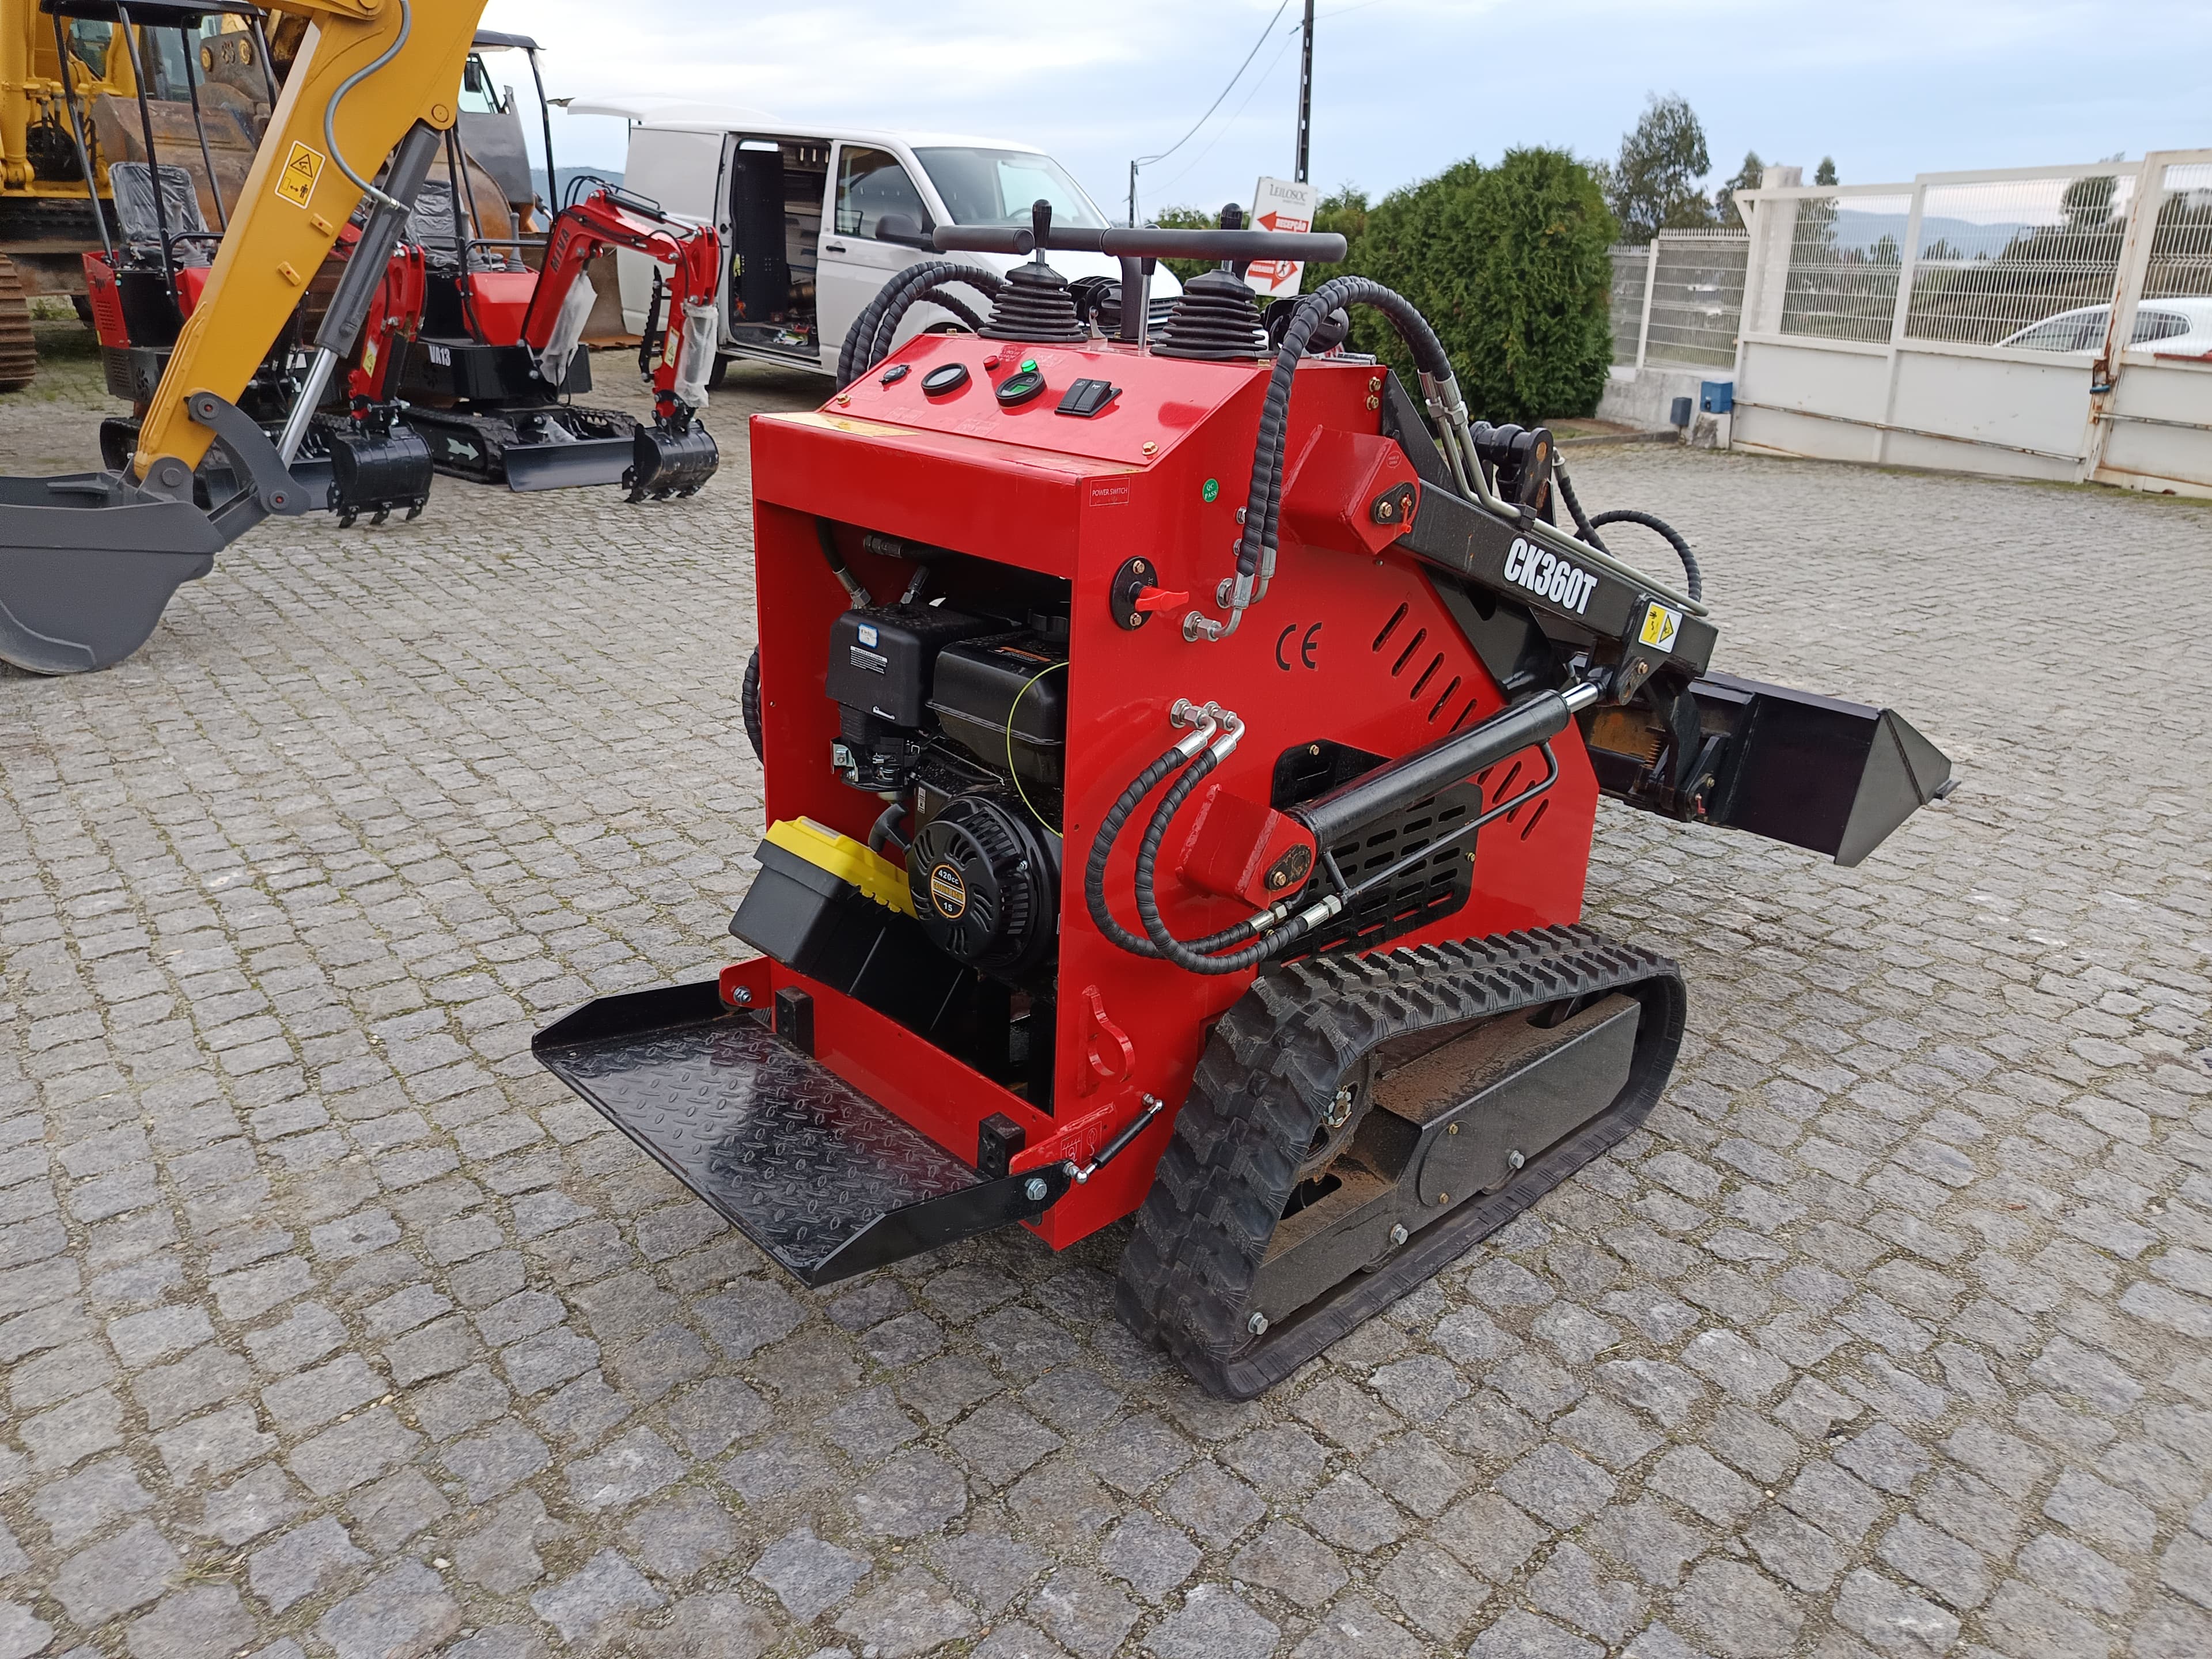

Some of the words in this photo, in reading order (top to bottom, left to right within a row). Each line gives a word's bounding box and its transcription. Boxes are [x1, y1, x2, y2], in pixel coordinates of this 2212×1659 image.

[551, 228, 570, 272] MIVA
[429, 346, 451, 366] VA13
[1205, 490, 1217, 499] PASS
[1504, 537, 1598, 615] CK360T
[938, 870, 959, 884] 420cc
[944, 902, 953, 912] 15
